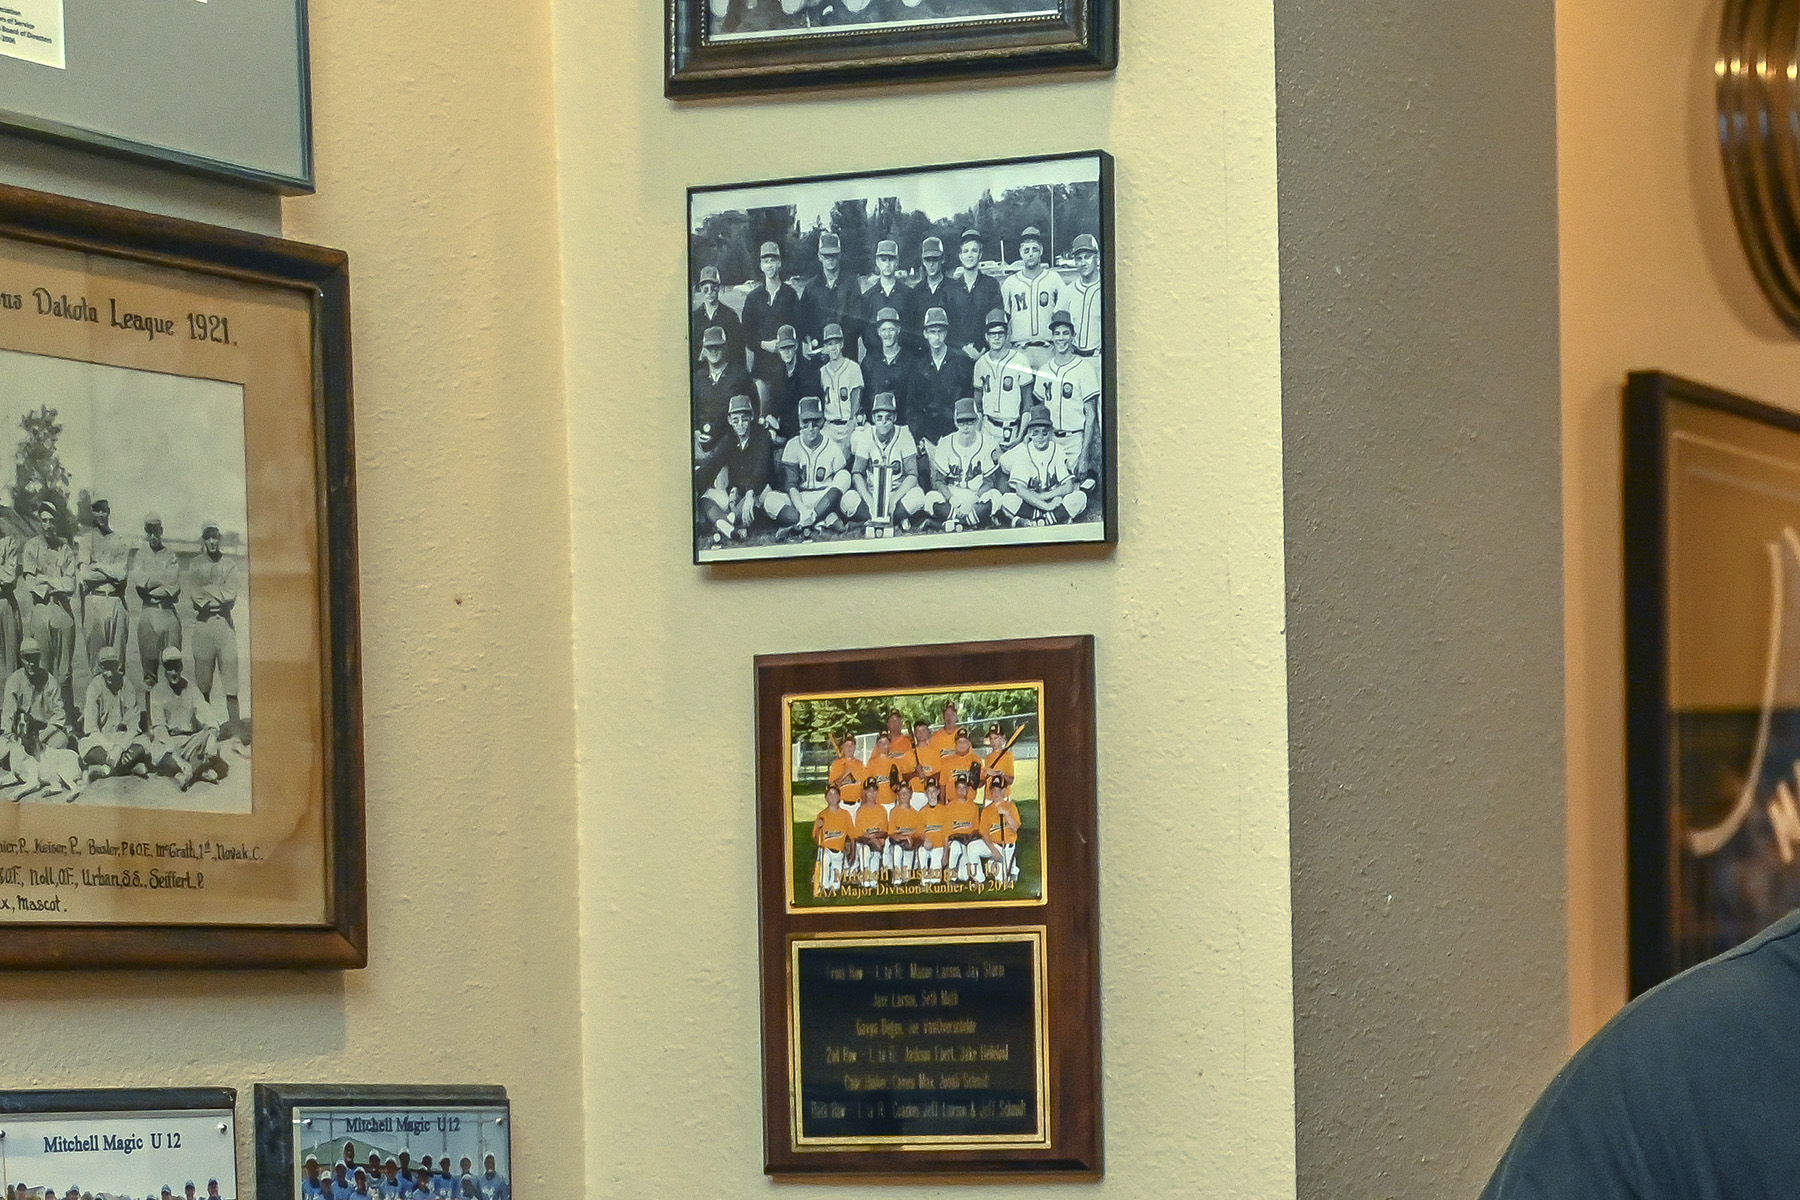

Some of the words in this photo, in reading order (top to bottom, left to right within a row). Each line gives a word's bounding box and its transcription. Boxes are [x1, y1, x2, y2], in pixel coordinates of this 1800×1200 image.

[33, 287, 99, 323] Dakota
[110, 297, 174, 341] League
[841, 884, 873, 898] Major
[876, 882, 921, 896] Division
[988, 879, 1015, 892] 2014
[345, 1117, 393, 1133] Mitchell
[396, 1116, 431, 1136] Magic
[44, 1134, 99, 1153] Mitchell
[103, 1133, 144, 1154] Magic
[151, 1133, 162, 1149] U
[166, 1132, 182, 1149] 12
